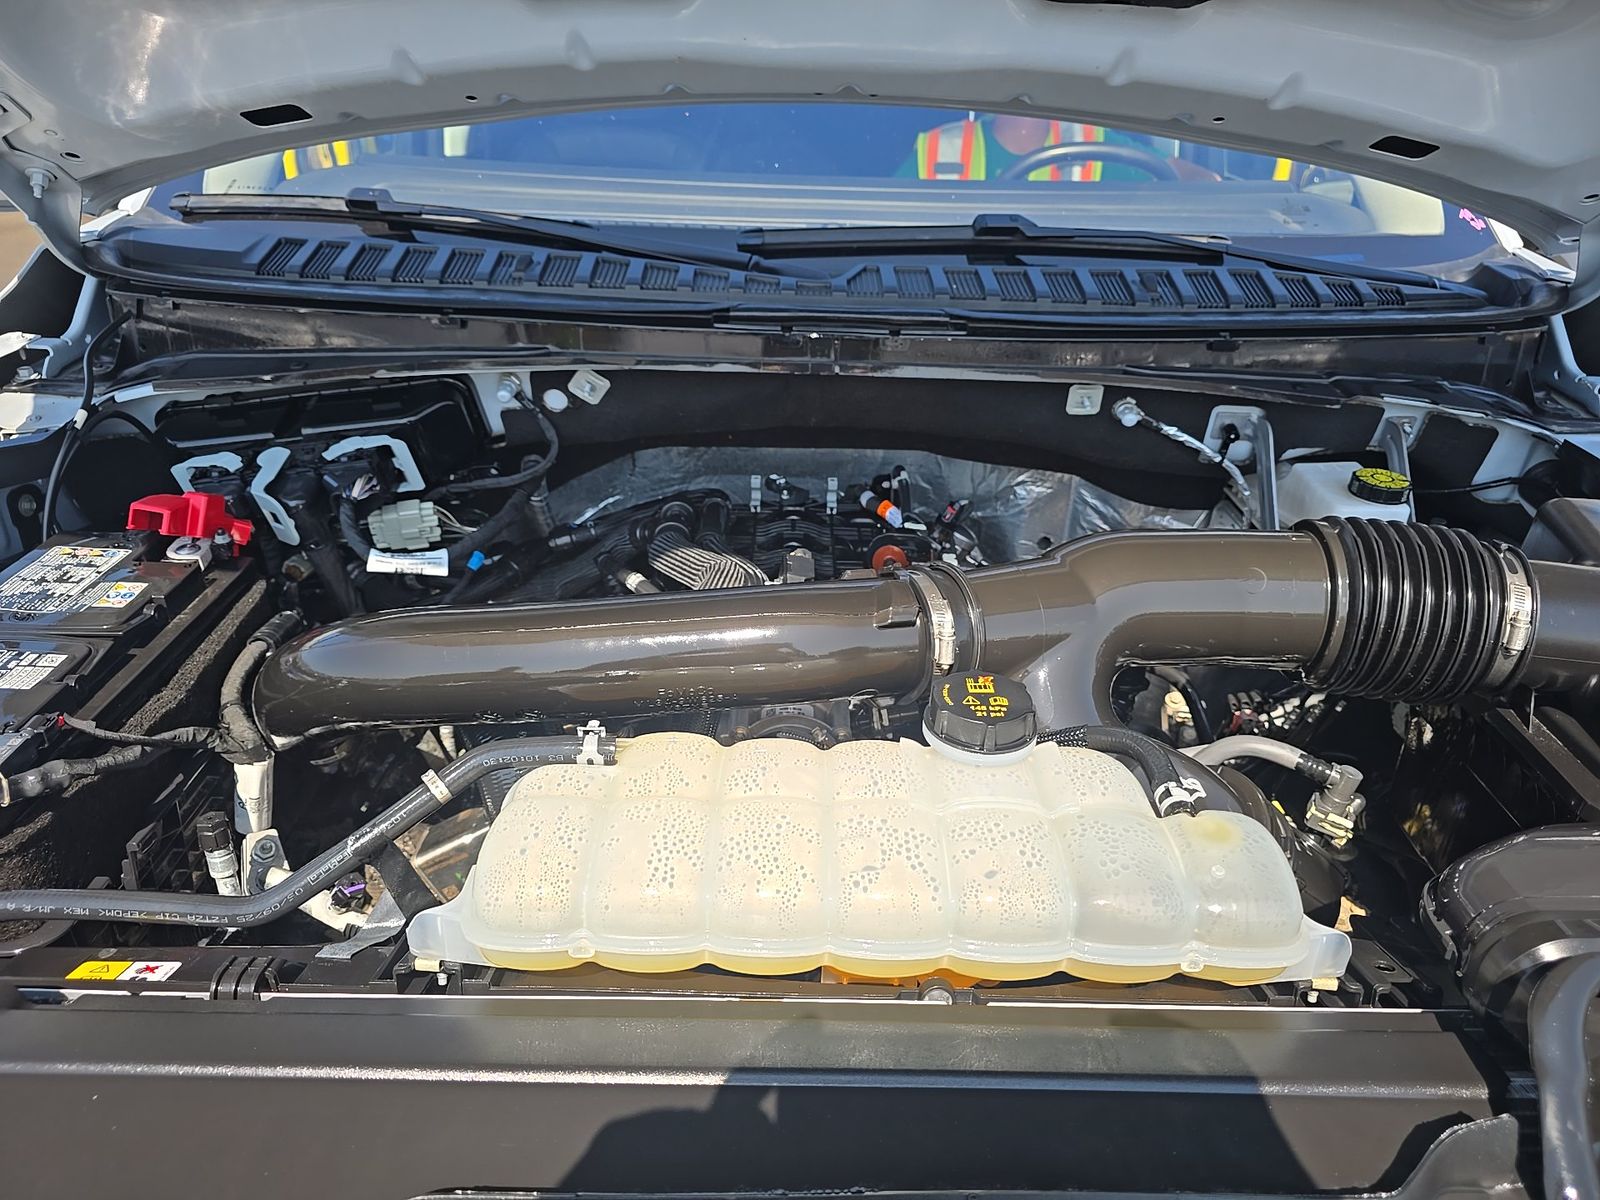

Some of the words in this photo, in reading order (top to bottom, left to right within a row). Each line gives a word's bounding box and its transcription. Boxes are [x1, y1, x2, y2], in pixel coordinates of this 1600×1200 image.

[482, 754, 540, 767] 10:02:30
[308, 850, 351, 884] FoMoCo
[63, 906, 90, 916] MEX
[98, 909, 148, 919] >EPDM<
